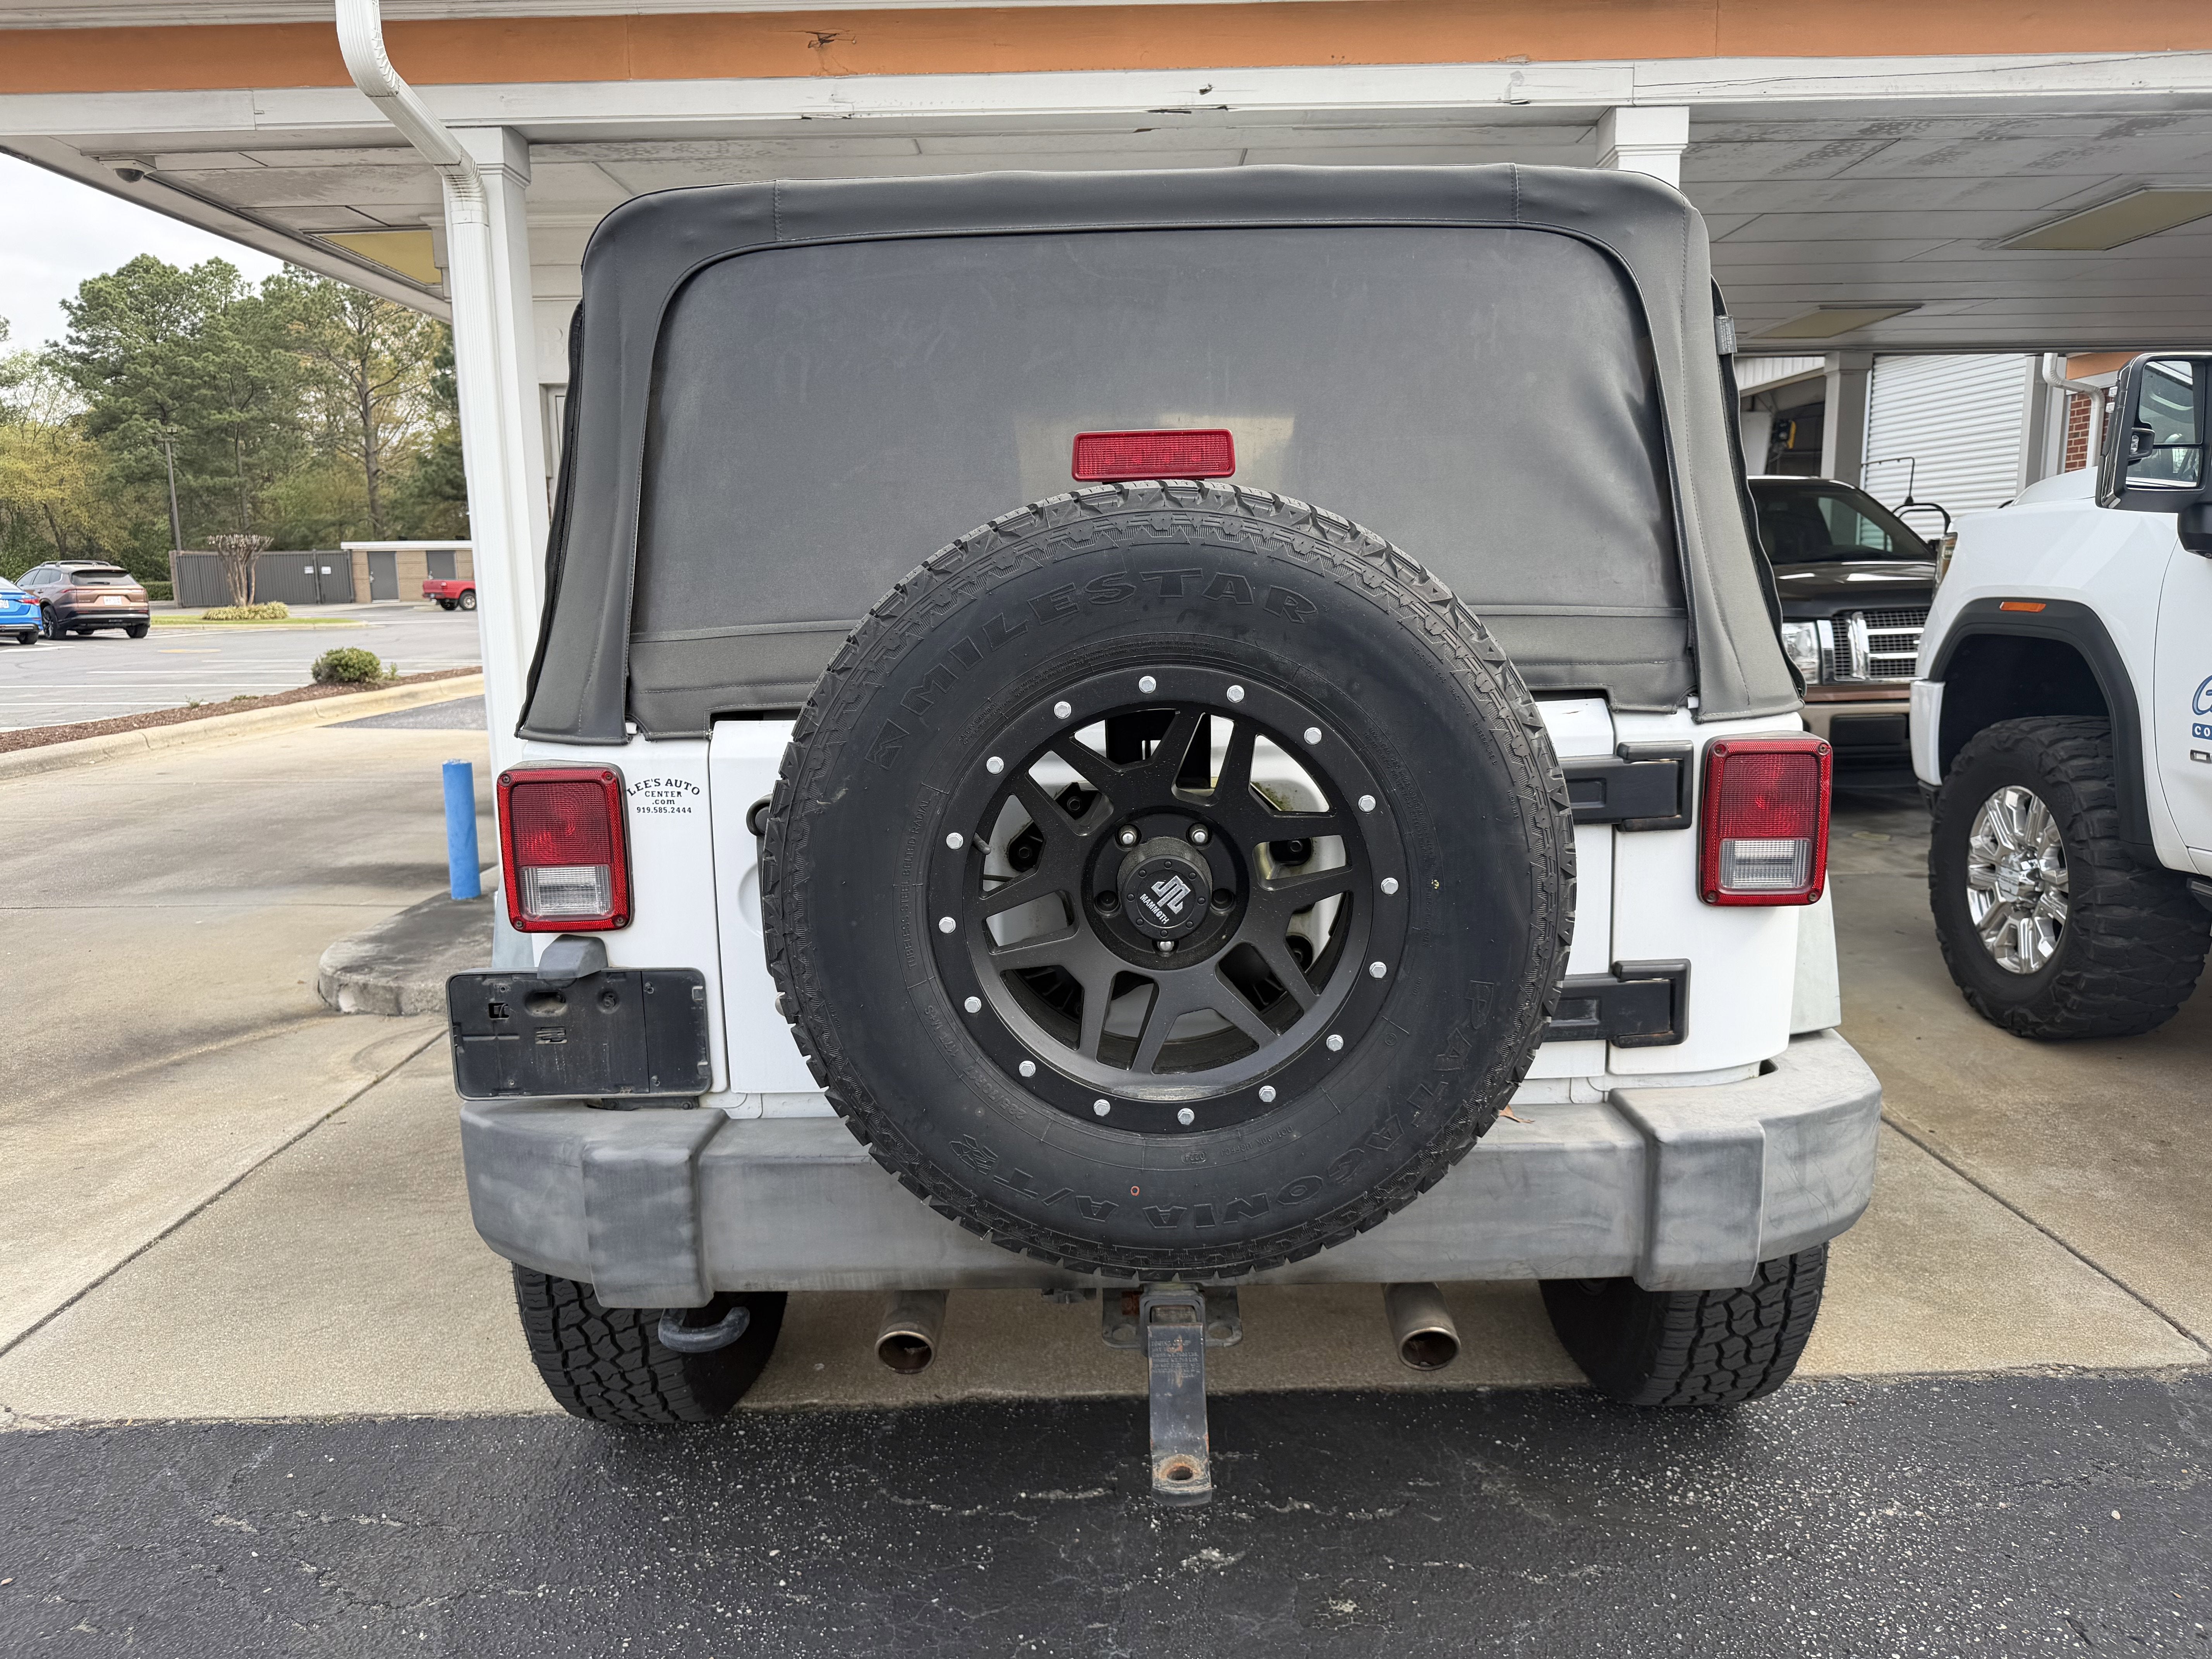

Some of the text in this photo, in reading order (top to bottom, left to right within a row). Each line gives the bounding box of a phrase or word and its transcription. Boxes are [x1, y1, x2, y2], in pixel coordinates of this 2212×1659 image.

[900, 568, 1317, 716] MILESTAR
[627, 778, 700, 796] LEE'S AUTO
[911, 799, 931, 834] RADIAL
[900, 880, 910, 913] STEEL
[1140, 893, 1170, 924] MAMMOTH
[900, 917, 917, 969] TUBELESS
[1142, 980, 1494, 1229] PATAGONIA
[1184, 1152, 1205, 1162] 0224
